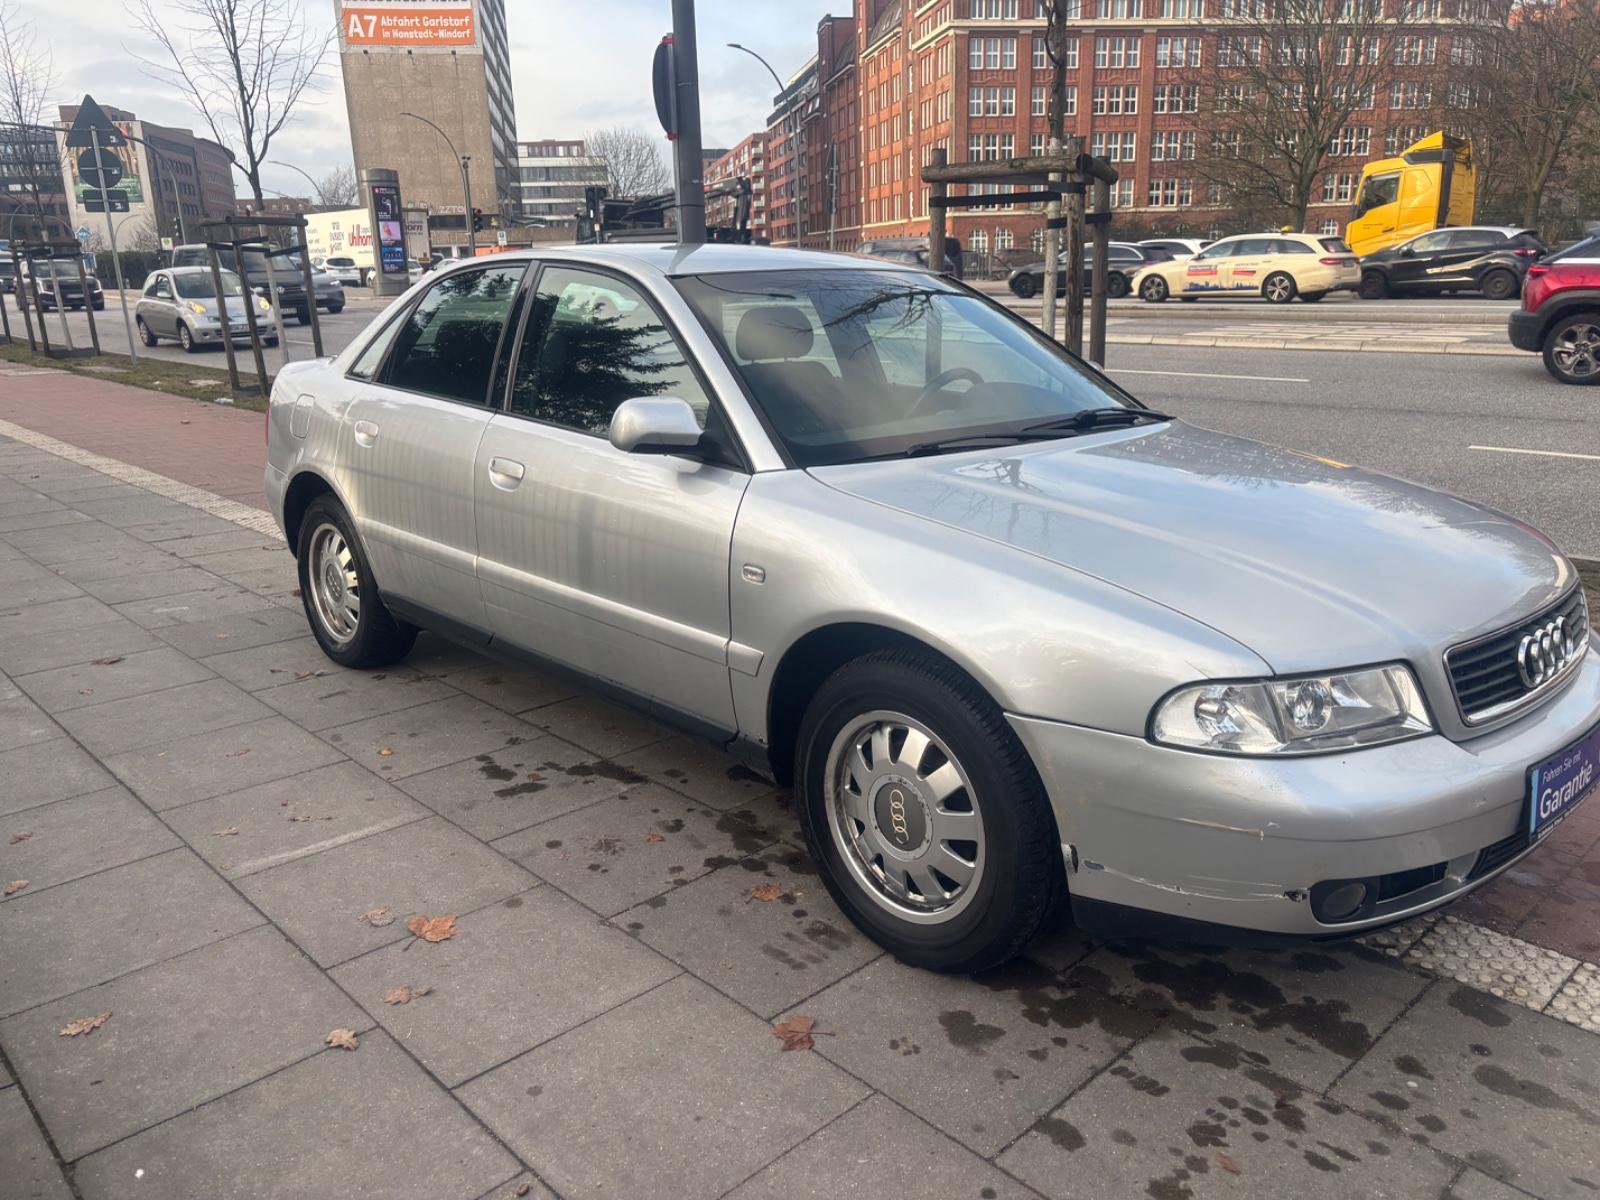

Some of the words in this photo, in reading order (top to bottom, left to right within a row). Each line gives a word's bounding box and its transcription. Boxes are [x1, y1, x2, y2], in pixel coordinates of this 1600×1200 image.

[348, 14, 378, 38] A7
[381, 16, 421, 27] Abfahrt
[422, 16, 470, 27] Garlstorf
[382, 29, 391, 38] in
[1542, 764, 1563, 785] Fahren
[1563, 757, 1573, 772] Sie
[1573, 750, 1582, 765] mit
[1540, 760, 1593, 819] Garantie
